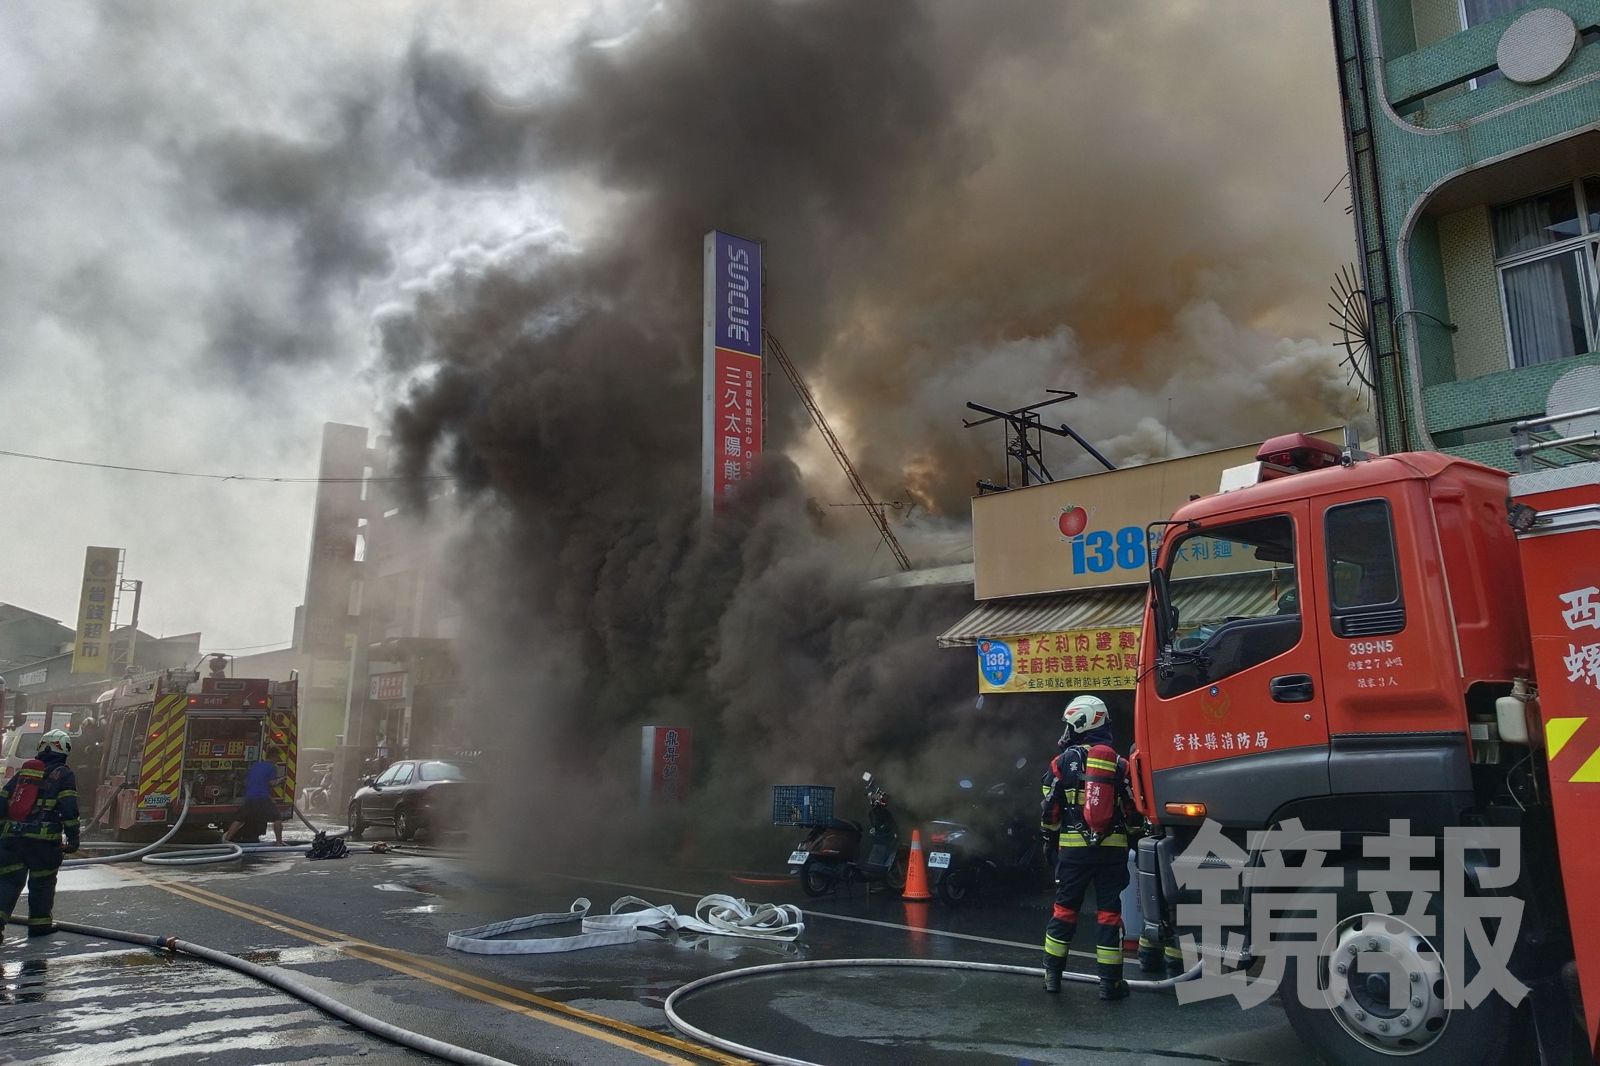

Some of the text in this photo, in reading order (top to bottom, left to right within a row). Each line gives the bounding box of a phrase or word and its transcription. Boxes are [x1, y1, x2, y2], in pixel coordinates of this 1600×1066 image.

[727, 244, 750, 345] SUNCUE
[1072, 526, 1146, 574] i38
[1017, 631, 1141, 656] 義大利肉醬麵
[1350, 640, 1394, 655] 399-N5
[1173, 731, 1268, 751] 雲林縣消防局
